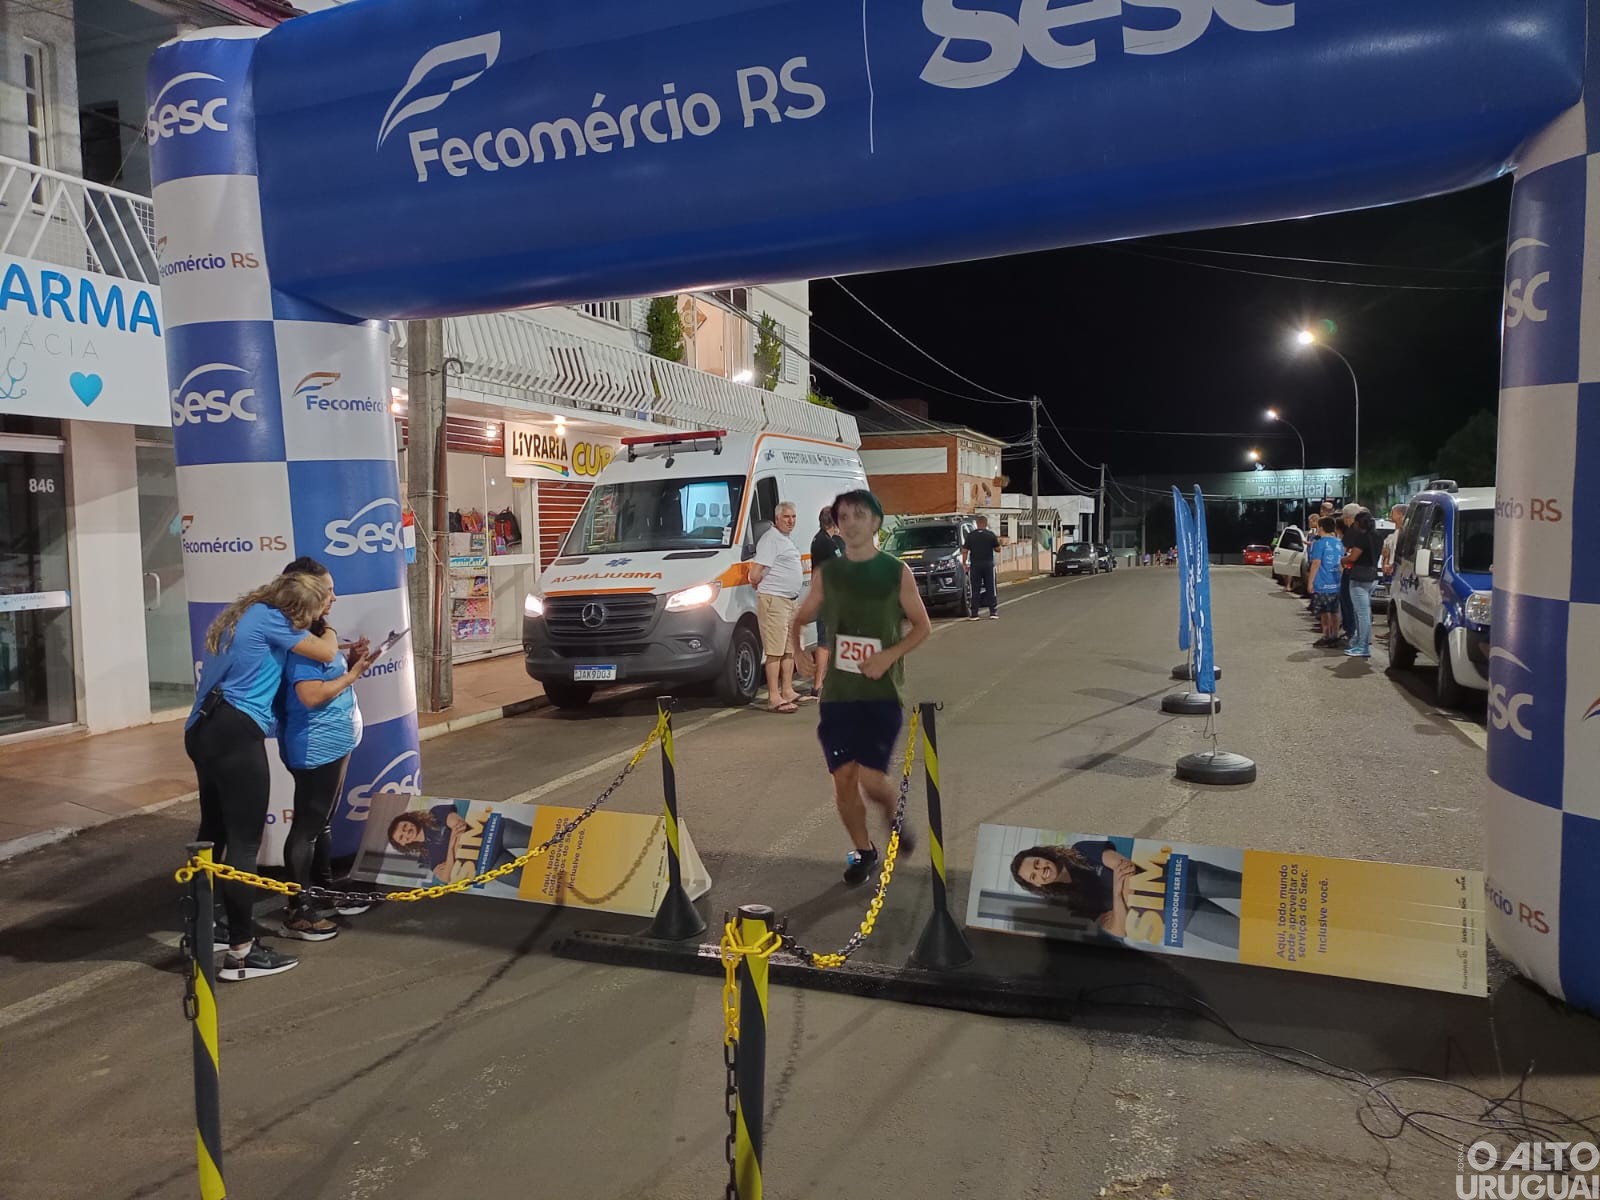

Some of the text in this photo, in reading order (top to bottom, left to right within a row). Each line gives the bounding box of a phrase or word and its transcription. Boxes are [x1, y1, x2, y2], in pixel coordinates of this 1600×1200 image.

[408, 56, 827, 183] Fecomércio RS
[230, 252, 260, 268] RS
[29, 478, 55, 493] 846
[1258, 485, 1291, 496] PADRE
[1530, 498, 1562, 522] RS
[259, 535, 288, 551] RS
[840, 640, 876, 661] 250
[567, 853, 580, 890] Inclusive
[548, 874, 557, 897] pode
[1172, 892, 1180, 917] PODEM
[1276, 864, 1289, 958] Aqui, todo mundo
[1286, 863, 1299, 962] pode aproveitar os
[1298, 869, 1309, 958] serviços do Sesc.
[1317, 878, 1329, 953] Inclusive você.
[1519, 902, 1550, 934] RS
